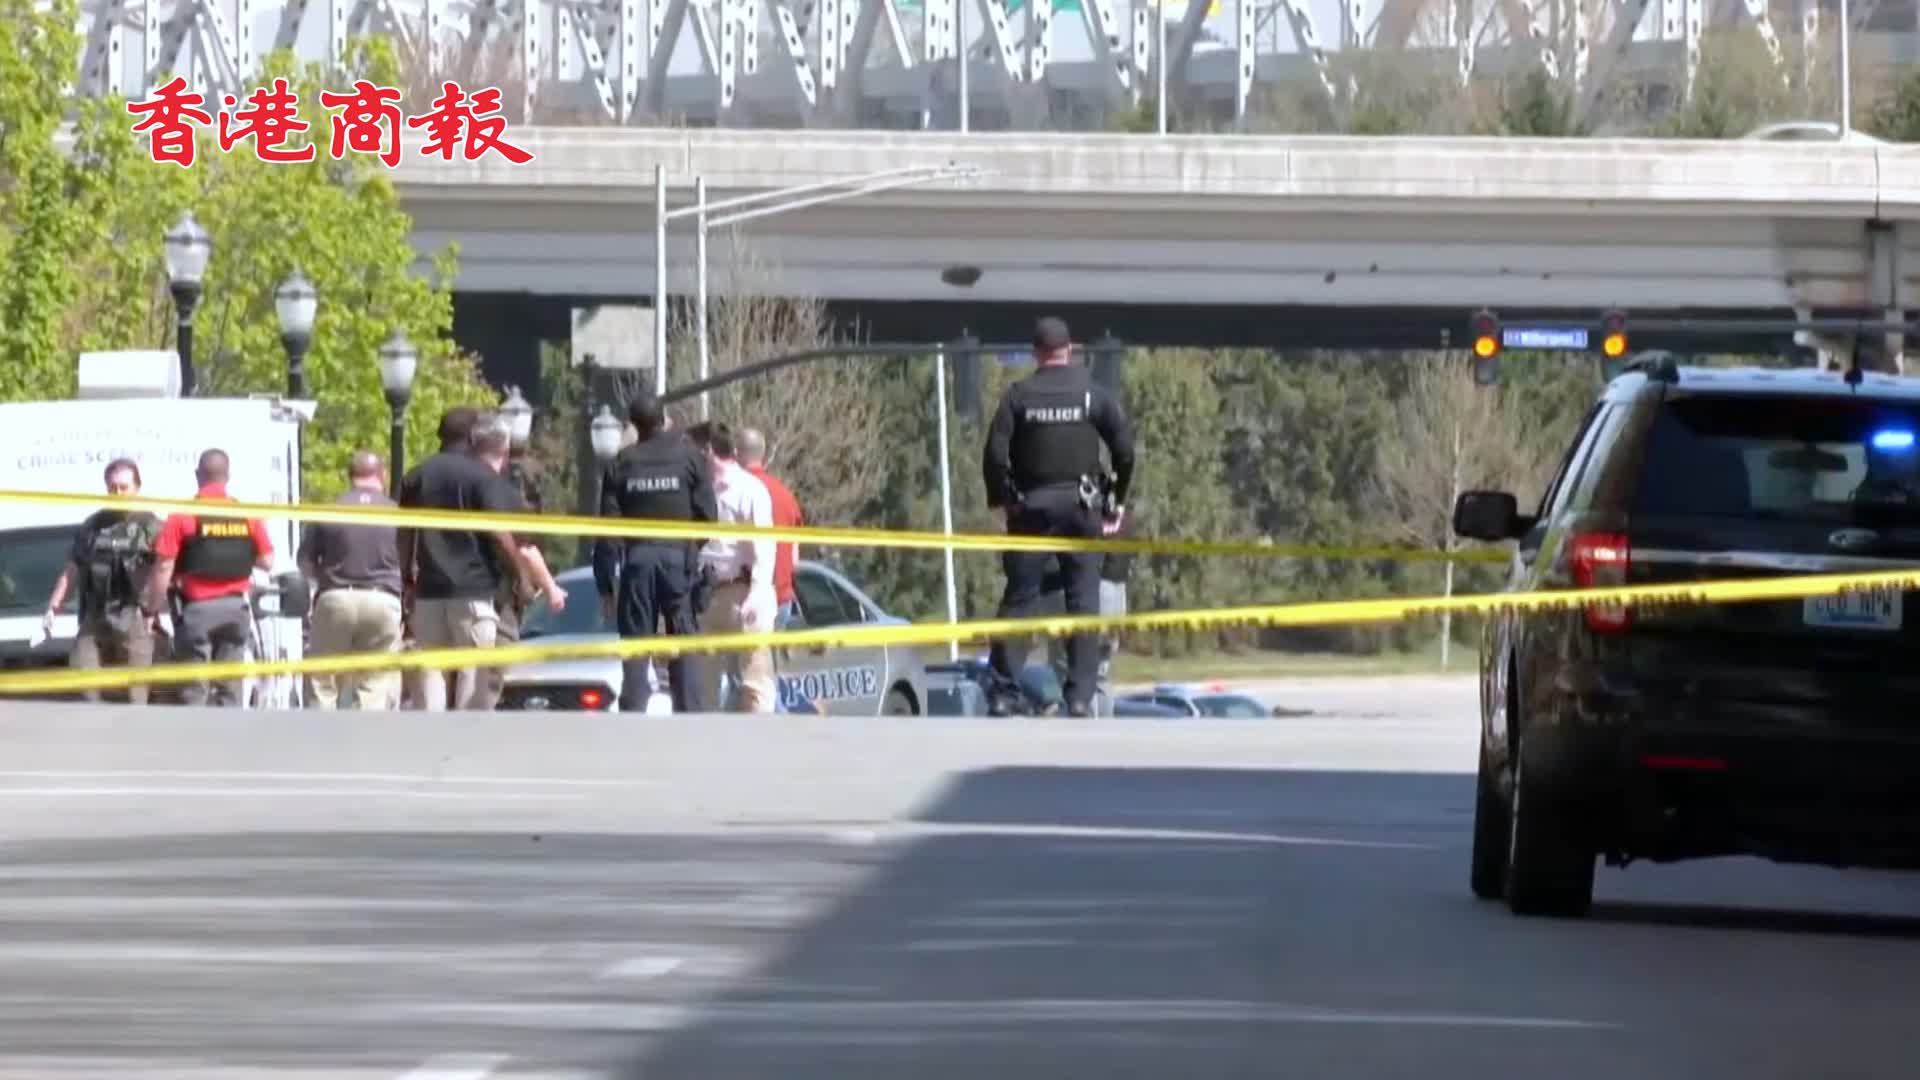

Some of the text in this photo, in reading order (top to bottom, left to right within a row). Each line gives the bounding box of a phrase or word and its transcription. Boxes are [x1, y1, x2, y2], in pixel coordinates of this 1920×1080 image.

[1026, 407, 1082, 423] POLICE
[626, 476, 680, 493] POLICE
[785, 666, 878, 708] POLICE
